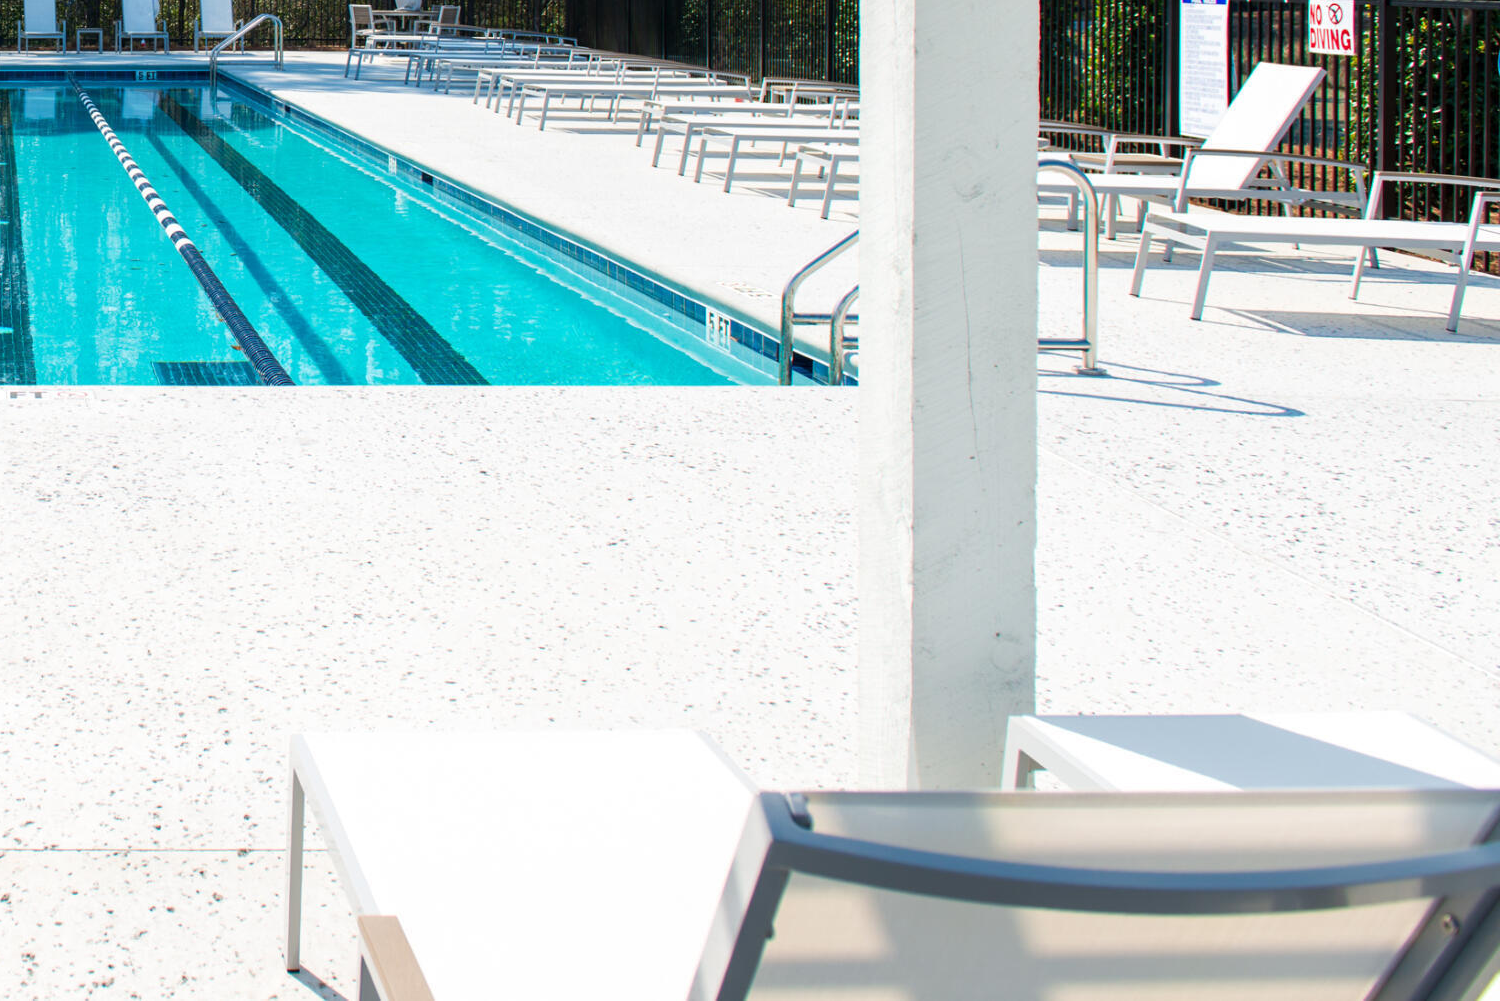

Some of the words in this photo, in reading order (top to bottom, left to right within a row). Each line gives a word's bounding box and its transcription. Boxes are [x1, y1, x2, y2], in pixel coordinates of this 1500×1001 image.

[1310, 4, 1322, 25] NO
[1310, 28, 1351, 50] DIVING
[718, 316, 730, 336] FT
[10, 391, 48, 399] FT
